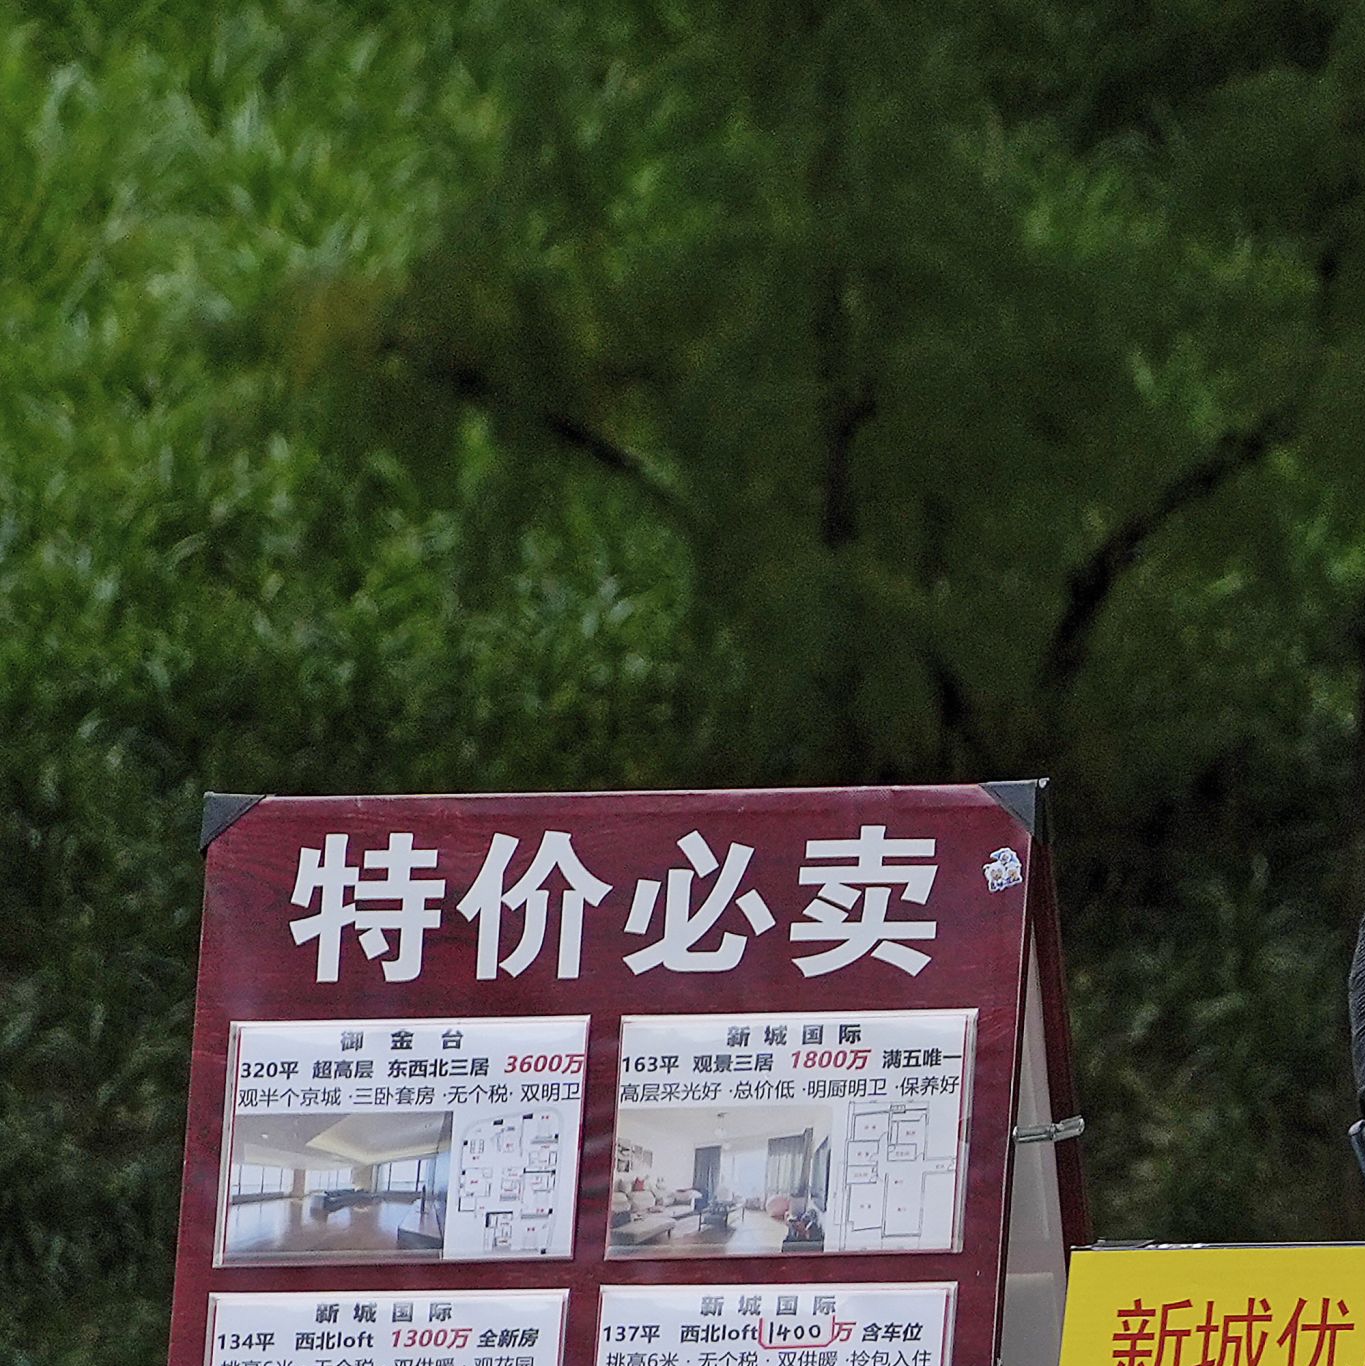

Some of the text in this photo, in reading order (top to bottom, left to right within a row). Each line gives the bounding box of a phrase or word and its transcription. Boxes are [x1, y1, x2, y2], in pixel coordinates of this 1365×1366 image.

[288, 825, 941, 984] 特价必卖
[341, 1030, 463, 1051] 御金台
[727, 1024, 861, 1047] 新城国际
[241, 1054, 584, 1079] 320平 超高层 东西北三居 3600万
[622, 1049, 962, 1072] 163平 观景三居 1800万 满五唯一
[239, 1087, 341, 1106] 观半个京城
[620, 1081, 721, 1102] 高层采光好
[316, 1302, 451, 1323] 新城国际
[701, 1295, 836, 1316] 新城国际
[218, 1328, 539, 1351] 134平 西北loft 1300万 全新房
[604, 1324, 660, 1342] 137平
[680, 1324, 758, 1342] 西北loft
[862, 1322, 922, 1341] 含车位
